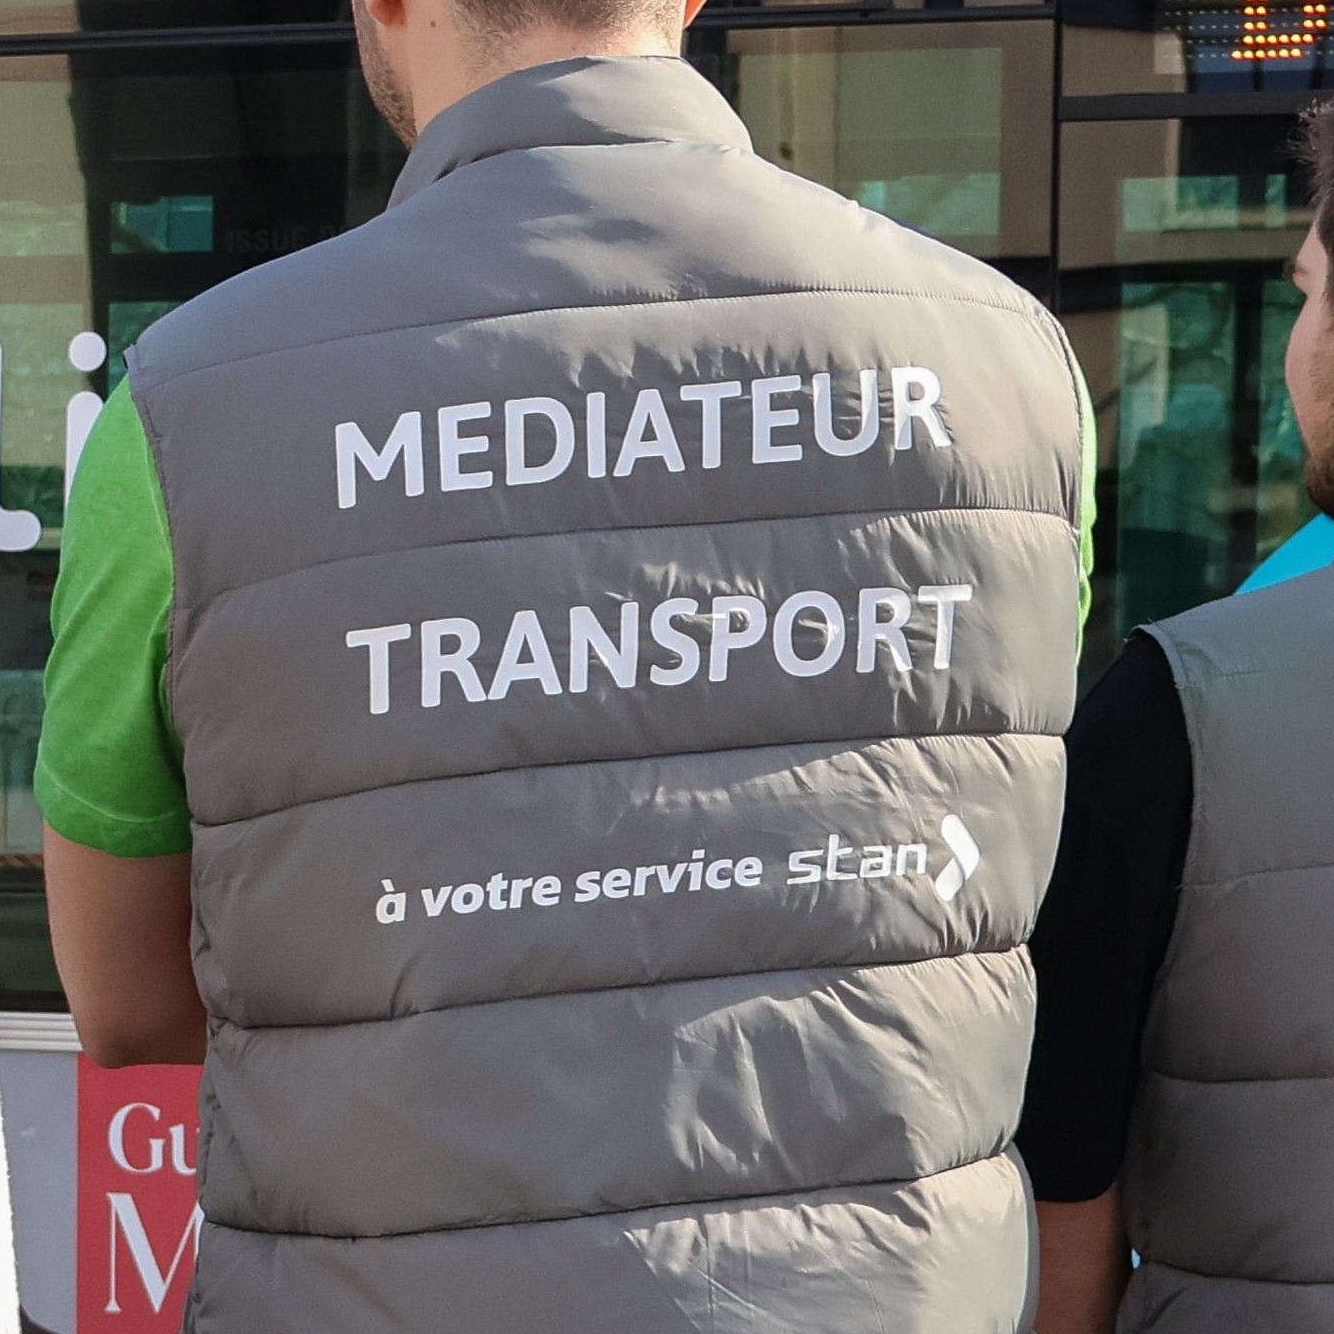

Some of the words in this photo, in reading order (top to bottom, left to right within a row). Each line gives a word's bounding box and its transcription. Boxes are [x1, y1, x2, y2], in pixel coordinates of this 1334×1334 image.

[334, 366, 954, 509] MEDIATEUR
[346, 584, 973, 714] TRANSPORT
[375, 879, 406, 924] à
[421, 871, 562, 918] votre
[574, 849, 763, 903] service
[787, 833, 927, 885] stan
